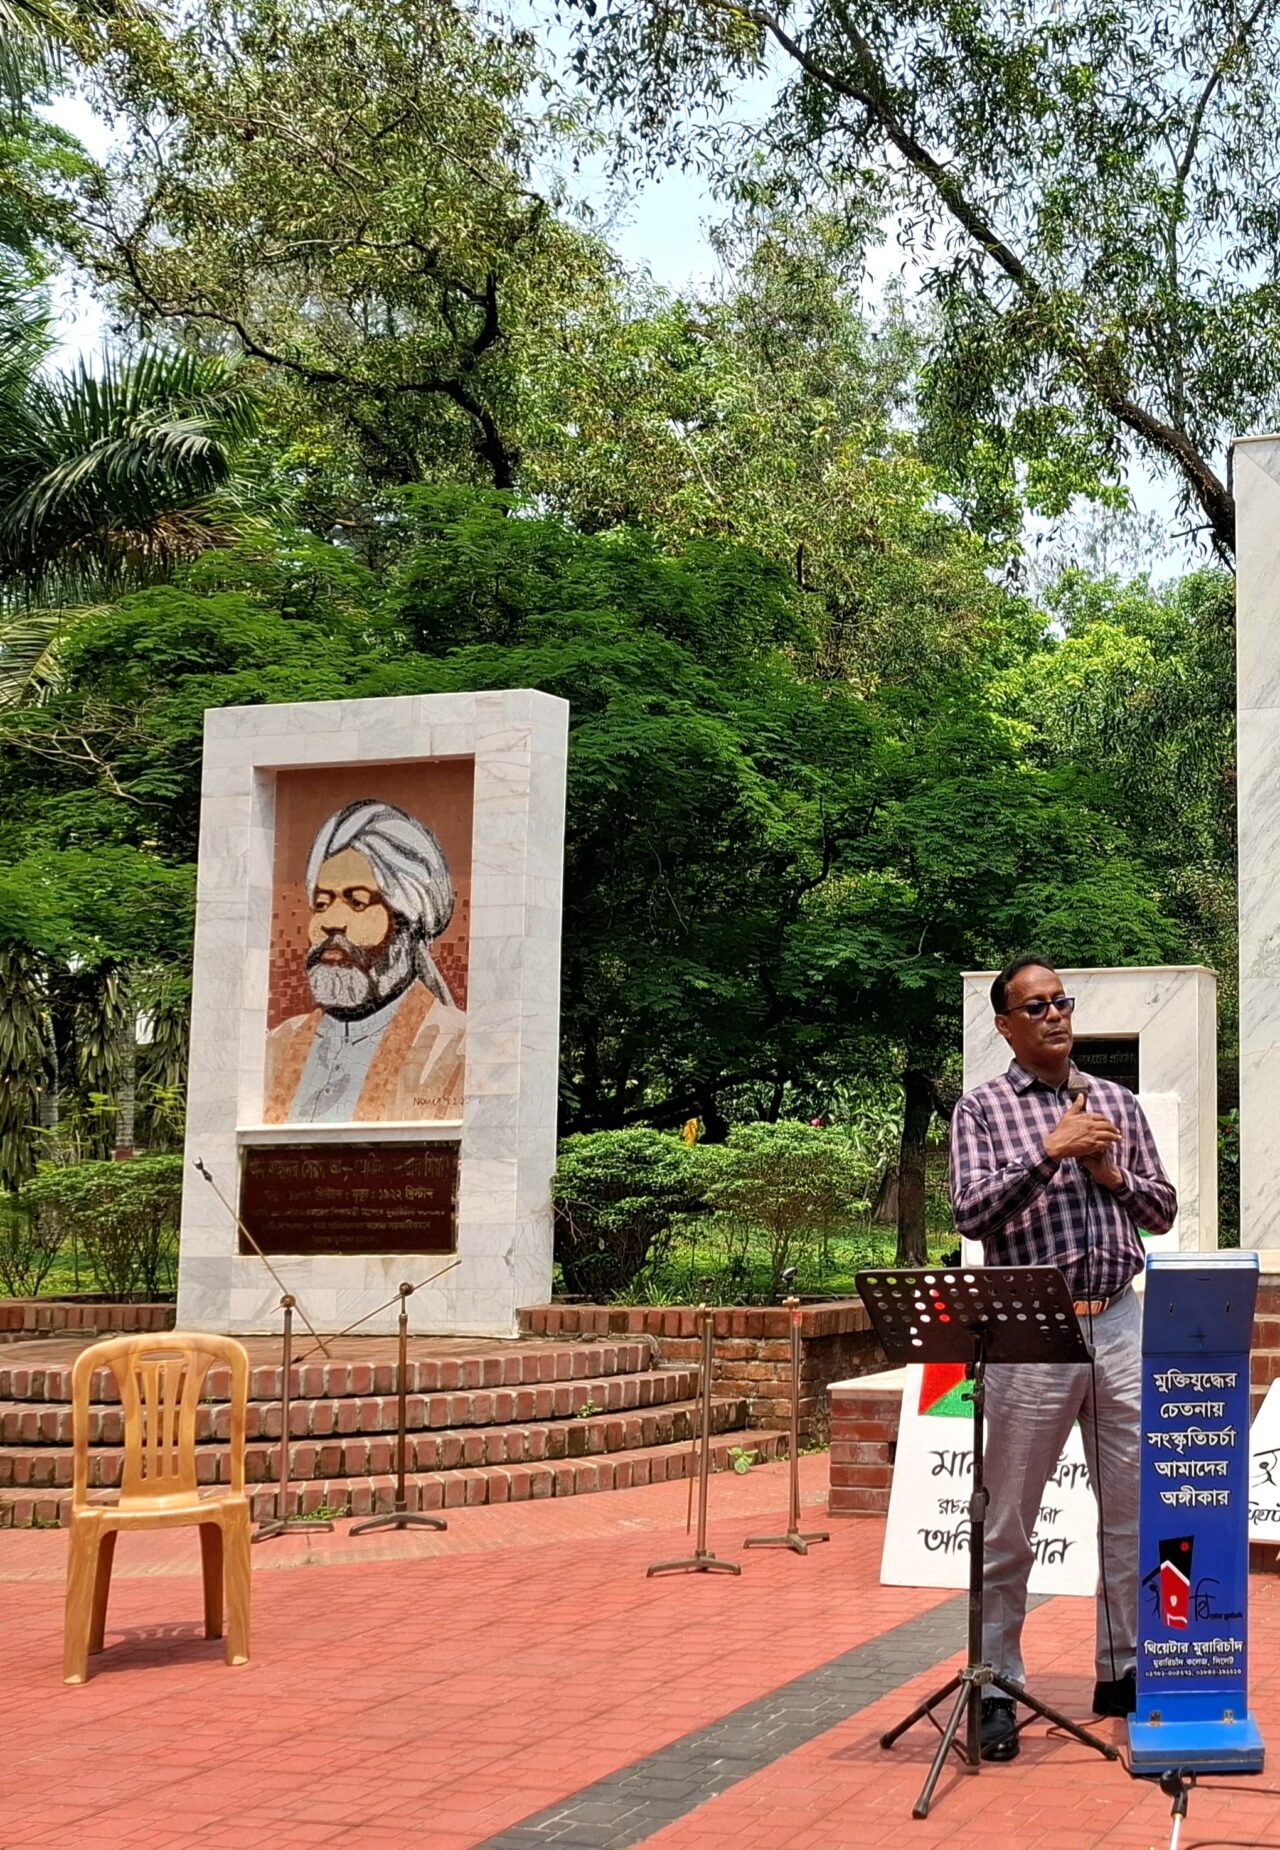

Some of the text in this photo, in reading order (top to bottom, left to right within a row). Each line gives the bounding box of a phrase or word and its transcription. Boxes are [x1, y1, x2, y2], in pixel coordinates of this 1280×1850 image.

[1153, 1368, 1238, 1393] মুক্তিযুদ্ধের
[1160, 1401, 1225, 1418] চেতনায়
[1147, 1425, 1237, 1455] সংস্কৃতিচর্চা
[1154, 1459, 1229, 1478] আমাদের
[1160, 1484, 1230, 1507] অঙ্গীকার
[1144, 1637, 1243, 1655] থিয়েটার মুরারিচাঁদ
